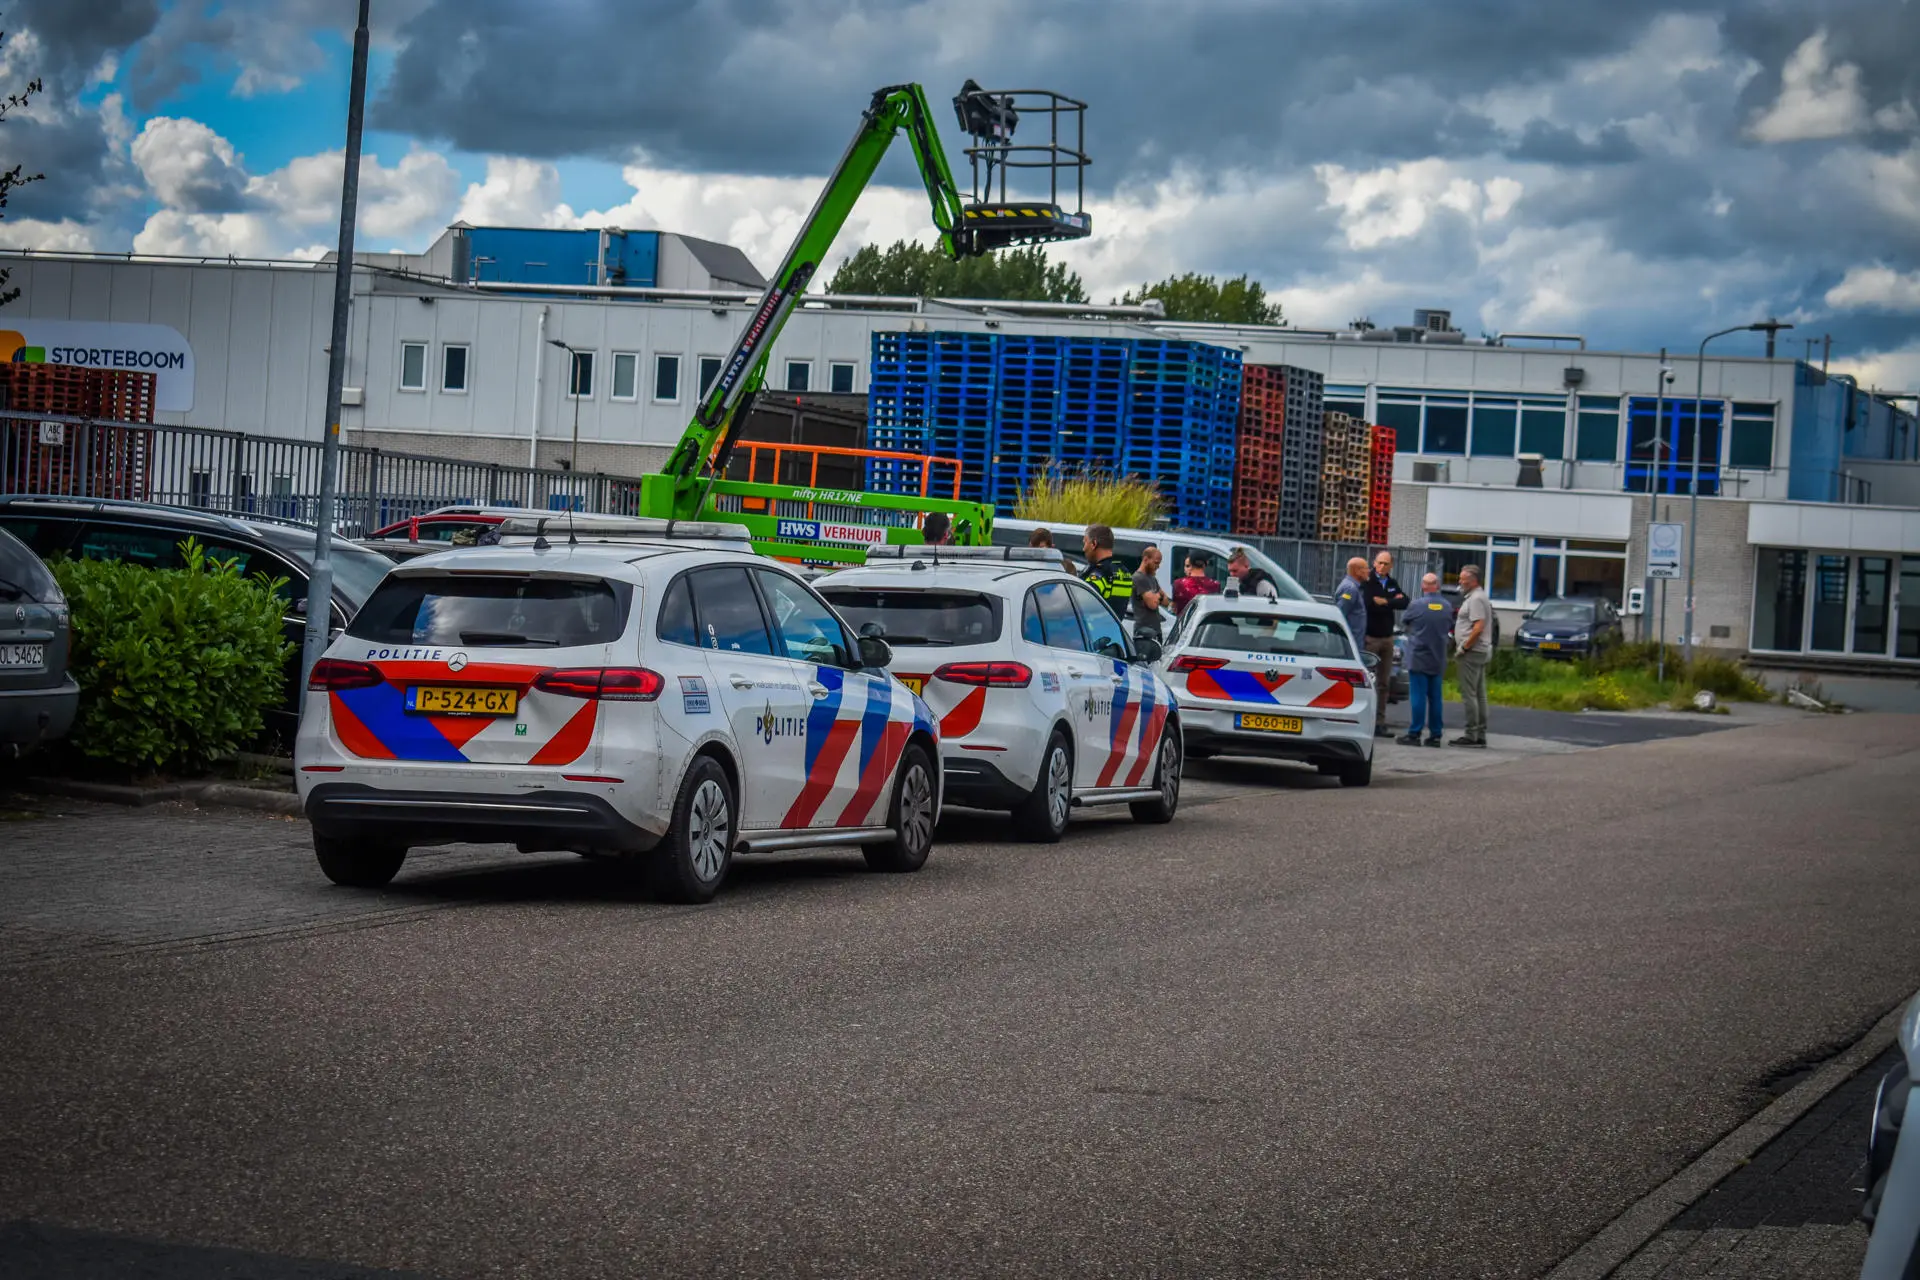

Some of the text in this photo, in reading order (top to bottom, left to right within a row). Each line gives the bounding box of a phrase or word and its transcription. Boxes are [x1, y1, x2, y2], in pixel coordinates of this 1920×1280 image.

[52, 347, 184, 369] STORTEBOOM
[792, 488, 863, 503] nifty HR17NE
[779, 520, 882, 543] HWS VERHUUR
[14, 645, 43, 664] 54625
[366, 649, 442, 660] POLITIE
[1247, 653, 1296, 664] POLITIE
[422, 690, 510, 711] P-524-GX
[1084, 699, 1111, 722] POLITIE
[756, 715, 805, 745] POLITIE
[1243, 715, 1299, 730] S-060-HB
